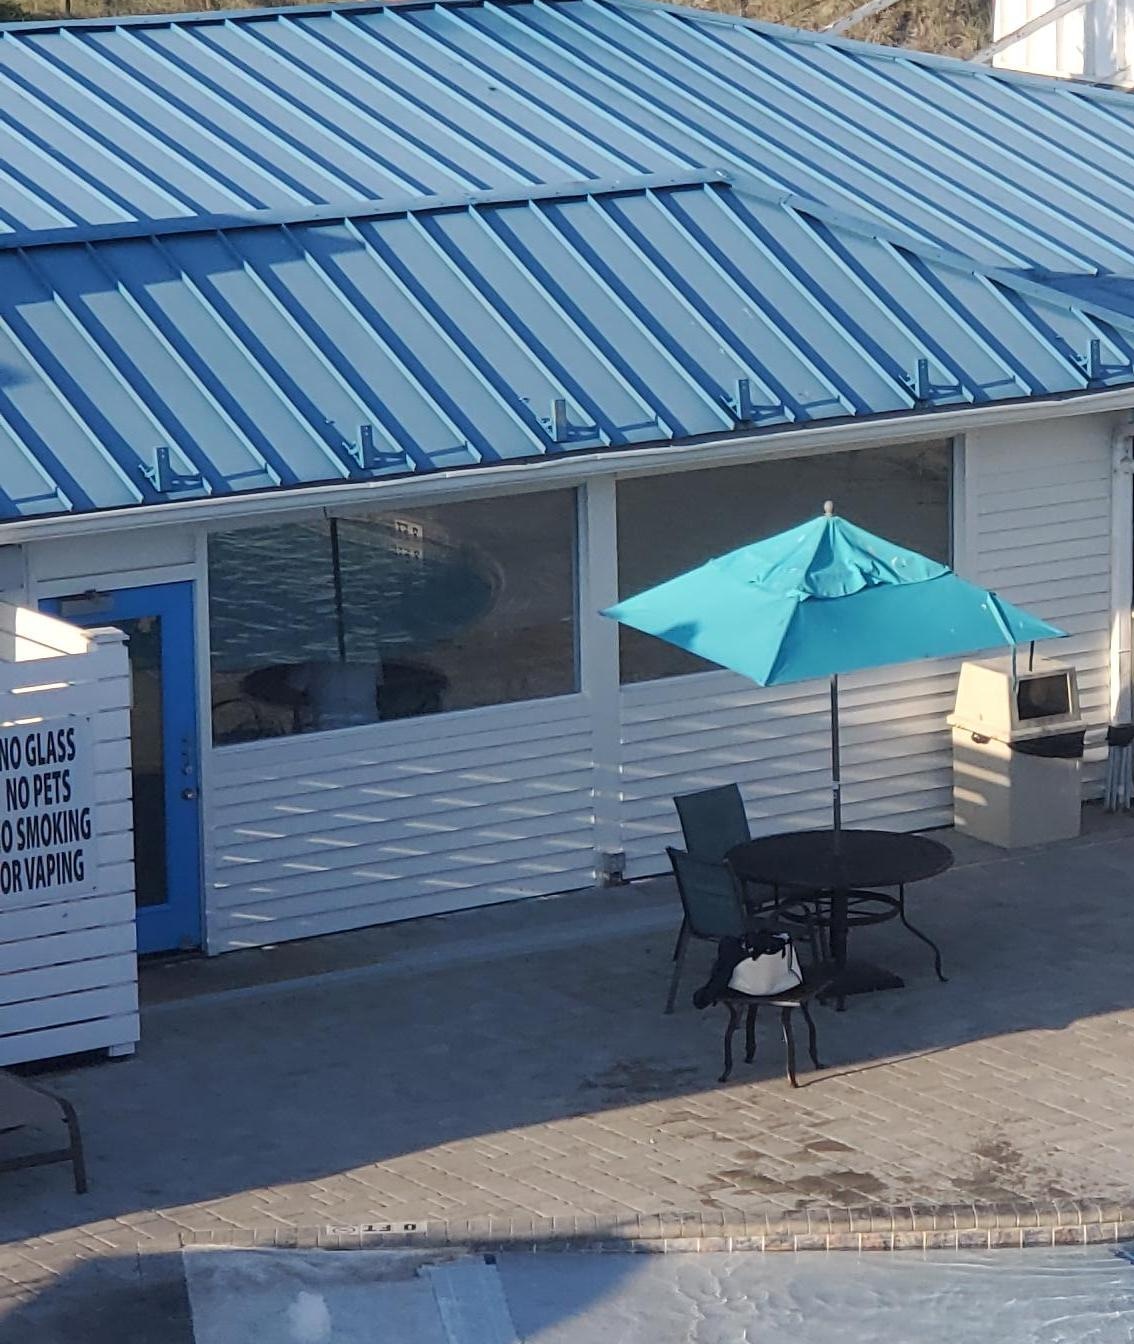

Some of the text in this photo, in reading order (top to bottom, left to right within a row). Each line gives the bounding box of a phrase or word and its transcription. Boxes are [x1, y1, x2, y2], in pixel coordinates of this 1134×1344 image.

[25, 727, 76, 767] GLASS
[6, 769, 71, 812] NO PETS
[0, 807, 91, 853] O SMOKING
[0, 849, 84, 895] OR VAPING
